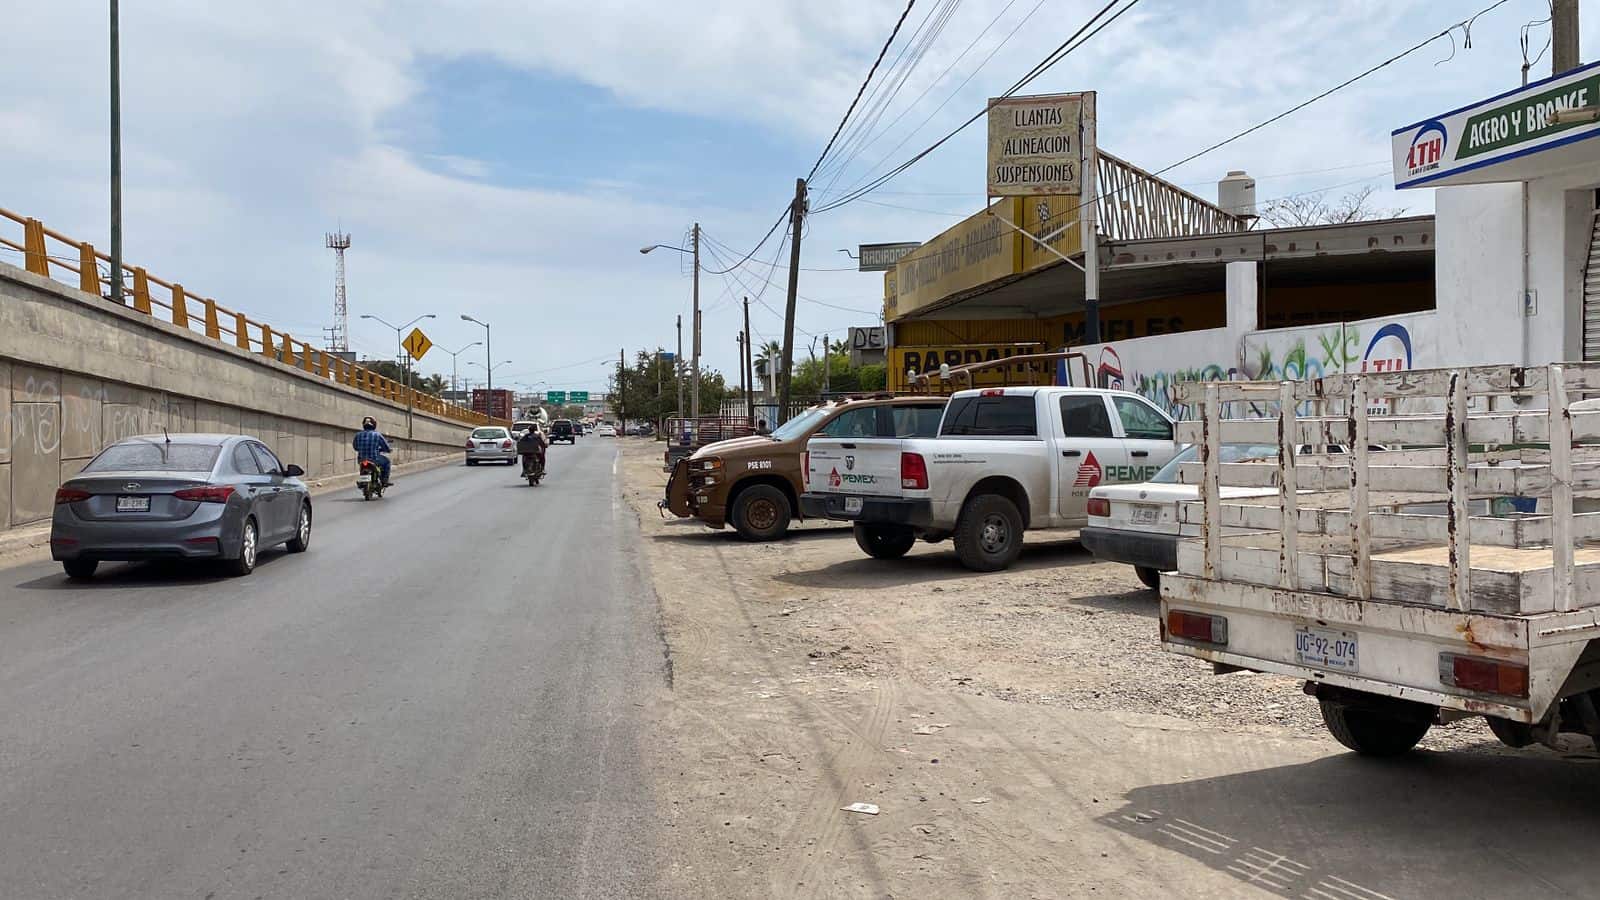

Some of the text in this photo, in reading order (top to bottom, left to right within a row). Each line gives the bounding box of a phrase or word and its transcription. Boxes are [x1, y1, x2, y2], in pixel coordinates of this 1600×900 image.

[1015, 107, 1063, 127] LLANTAS
[1470, 88, 1588, 149] ACERO Y BRONCE
[1004, 136, 1070, 156] ALINEACION
[1408, 138, 1441, 168] LTH
[995, 164, 1073, 184] SUSPENSIONES
[842, 474, 875, 484] PEMEX
[1296, 632, 1356, 659] UG-92-074
